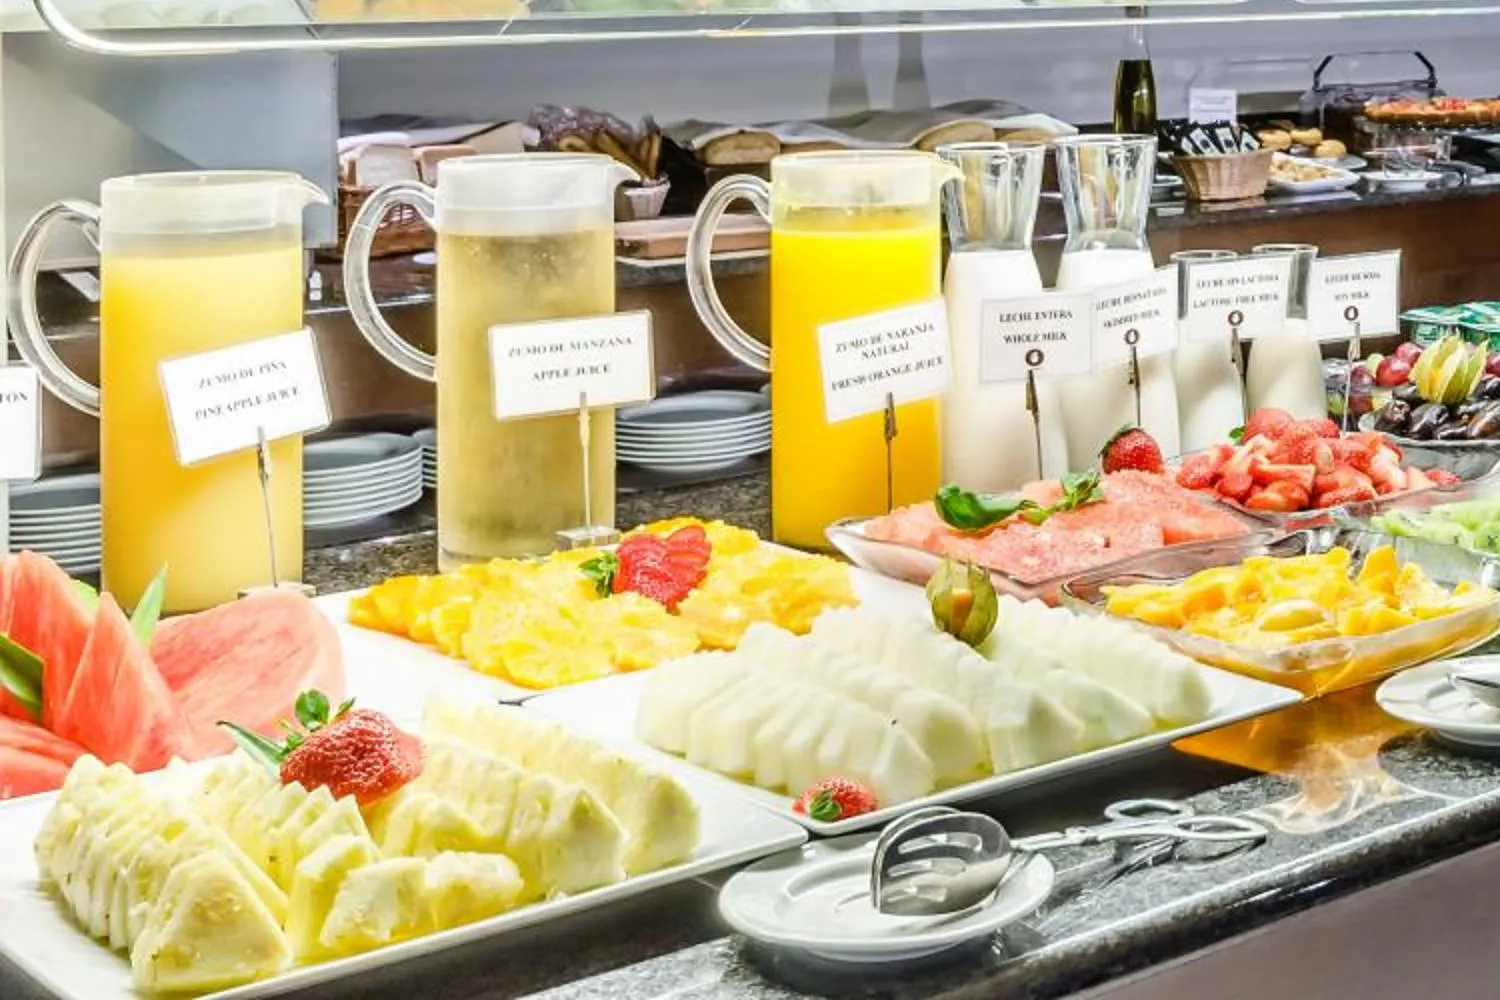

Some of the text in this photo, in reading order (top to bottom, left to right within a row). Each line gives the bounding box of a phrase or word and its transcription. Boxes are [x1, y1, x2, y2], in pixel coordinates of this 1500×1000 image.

[570, 336, 633, 351] MANZANA
[531, 363, 611, 382] APPLE JUICE
[831, 355, 944, 391] FRESH ORANGE JUICE
